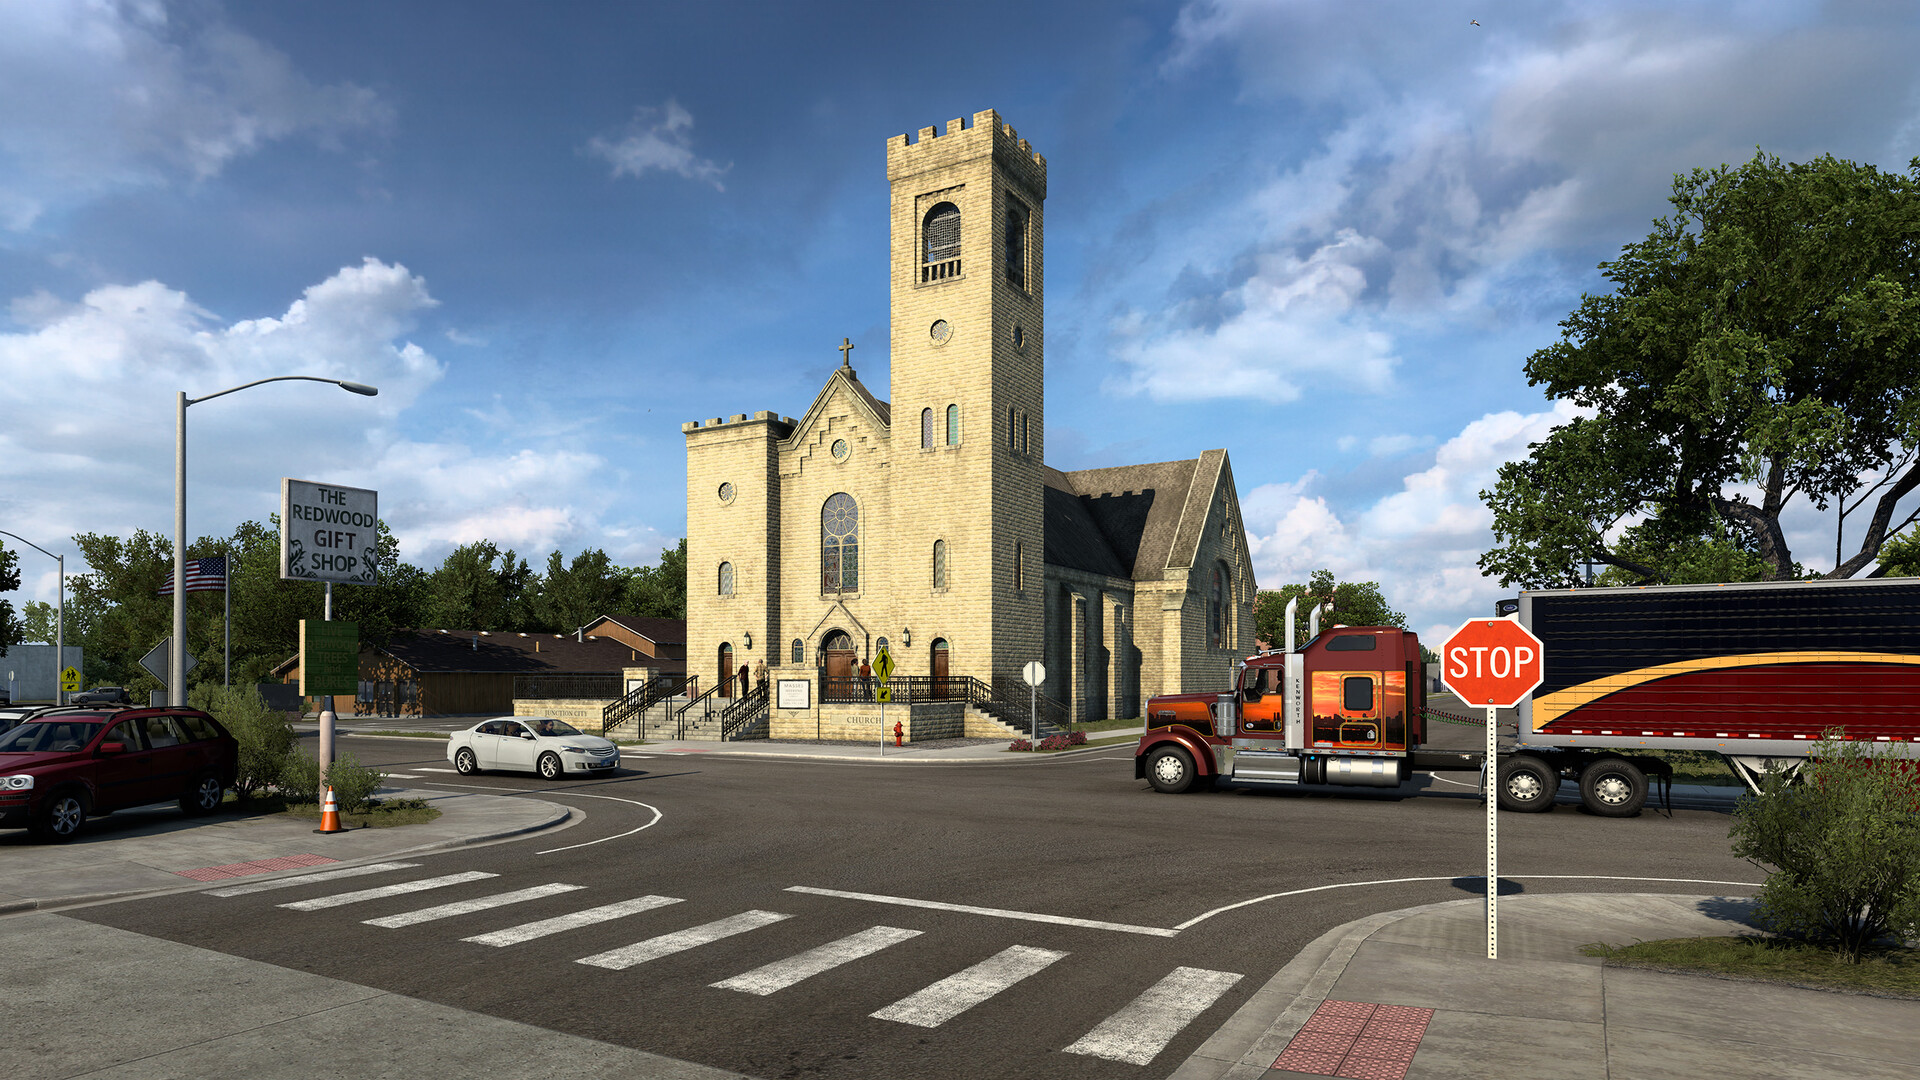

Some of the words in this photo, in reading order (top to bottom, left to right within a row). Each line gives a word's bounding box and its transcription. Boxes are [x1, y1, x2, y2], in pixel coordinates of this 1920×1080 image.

[318, 488, 346, 506] THE
[293, 504, 373, 528] REDWOOD
[314, 530, 356, 550] GIFT
[311, 553, 357, 572] SHOP
[321, 625, 343, 636] LIVE
[307, 640, 358, 655] REDWOOD
[317, 652, 349, 664] TREES
[1449, 646, 1534, 678] STOP
[314, 676, 350, 688] BURLS
[846, 716, 882, 724] CHURCH
